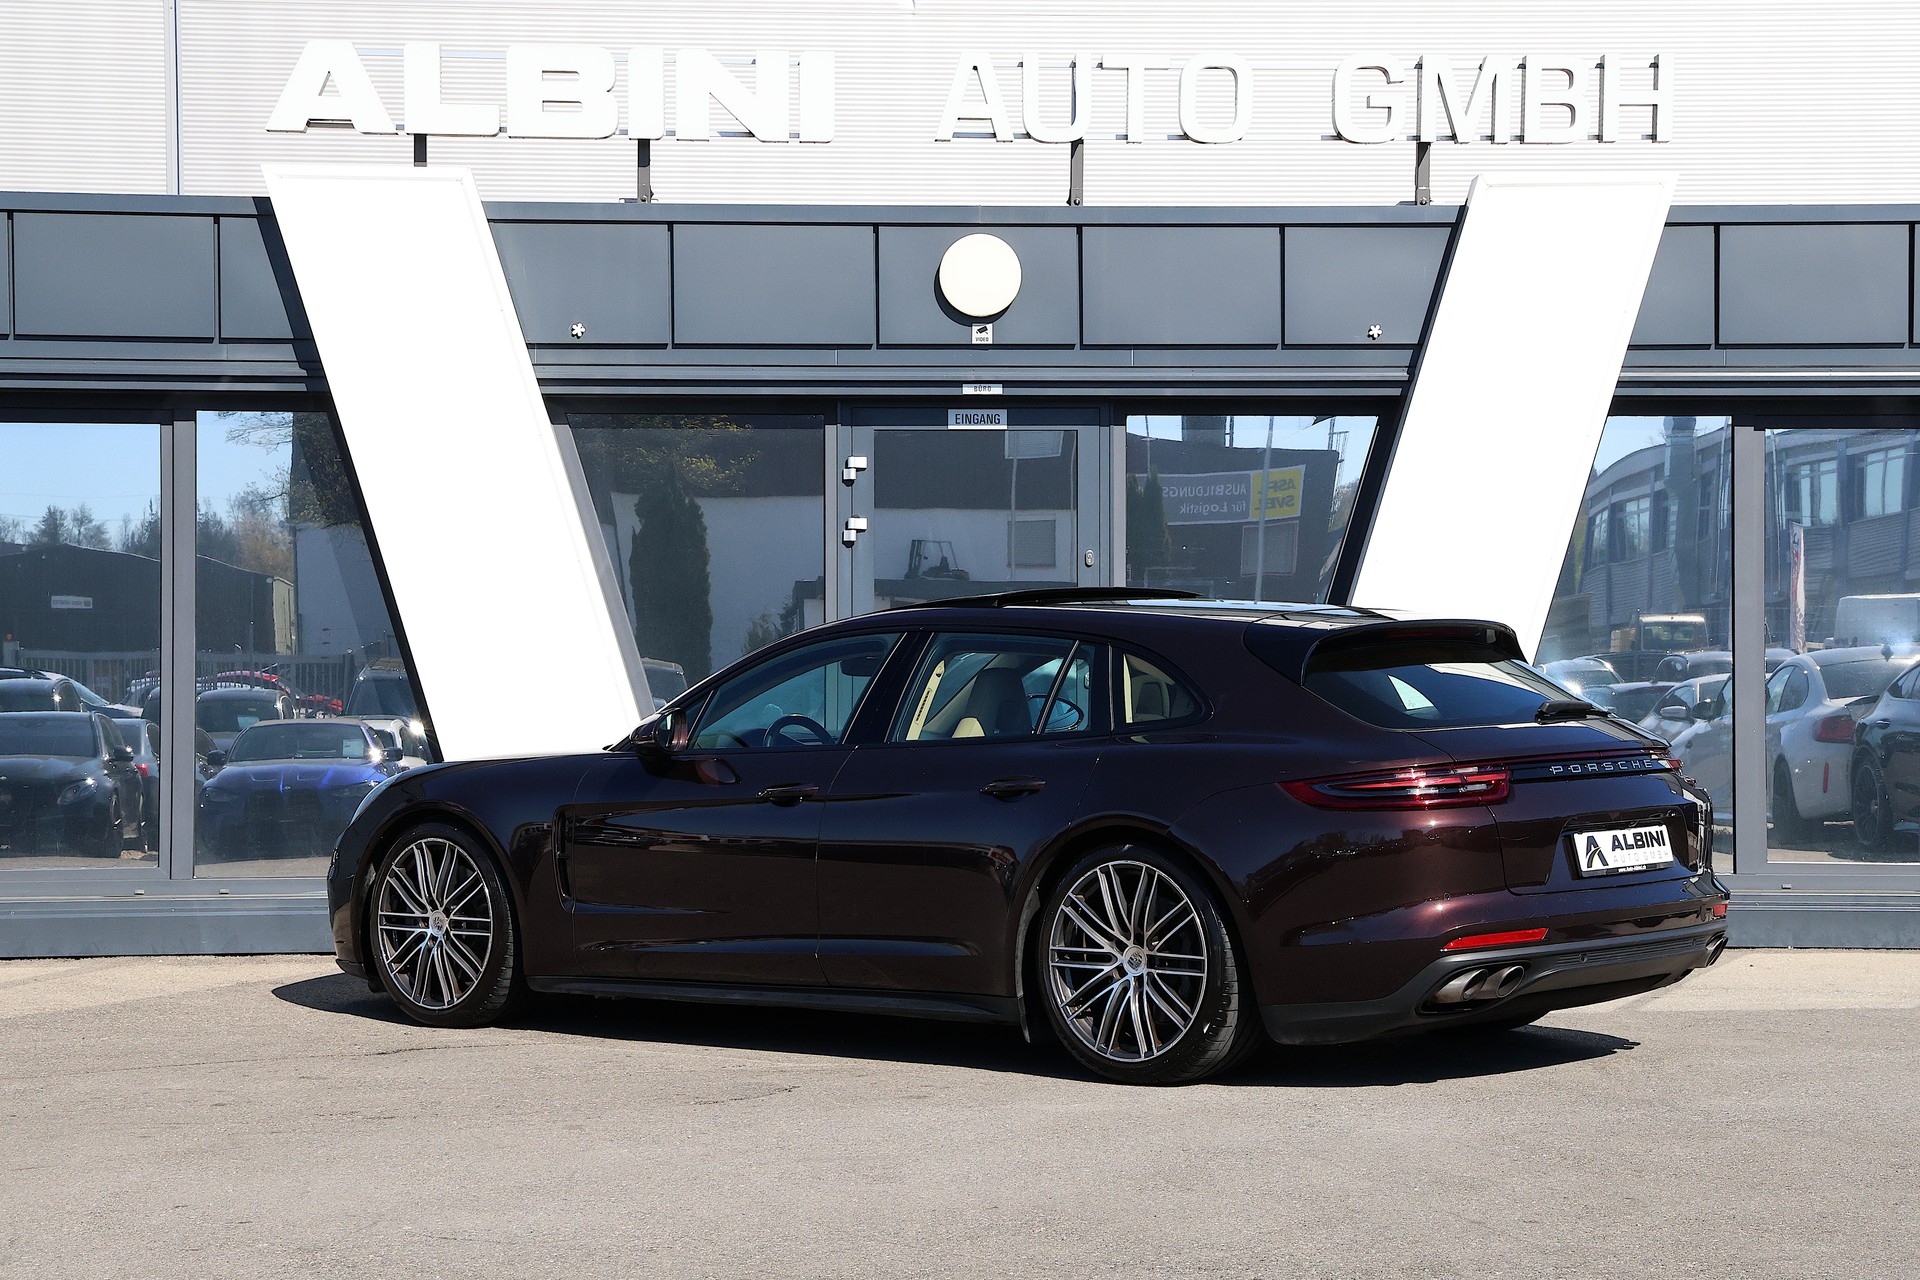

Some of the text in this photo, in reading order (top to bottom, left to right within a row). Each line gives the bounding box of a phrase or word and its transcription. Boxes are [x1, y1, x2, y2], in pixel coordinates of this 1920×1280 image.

[264, 39, 836, 143] ALBINI
[935, 50, 1674, 145] AUTO GMBH
[973, 384, 992, 392] BÜRO
[955, 413, 1001, 425] EINGANG
[1551, 759, 1653, 775] PORSCHE
[1611, 830, 1666, 851] ALBINI
[1613, 853, 1640, 864] AUTO
